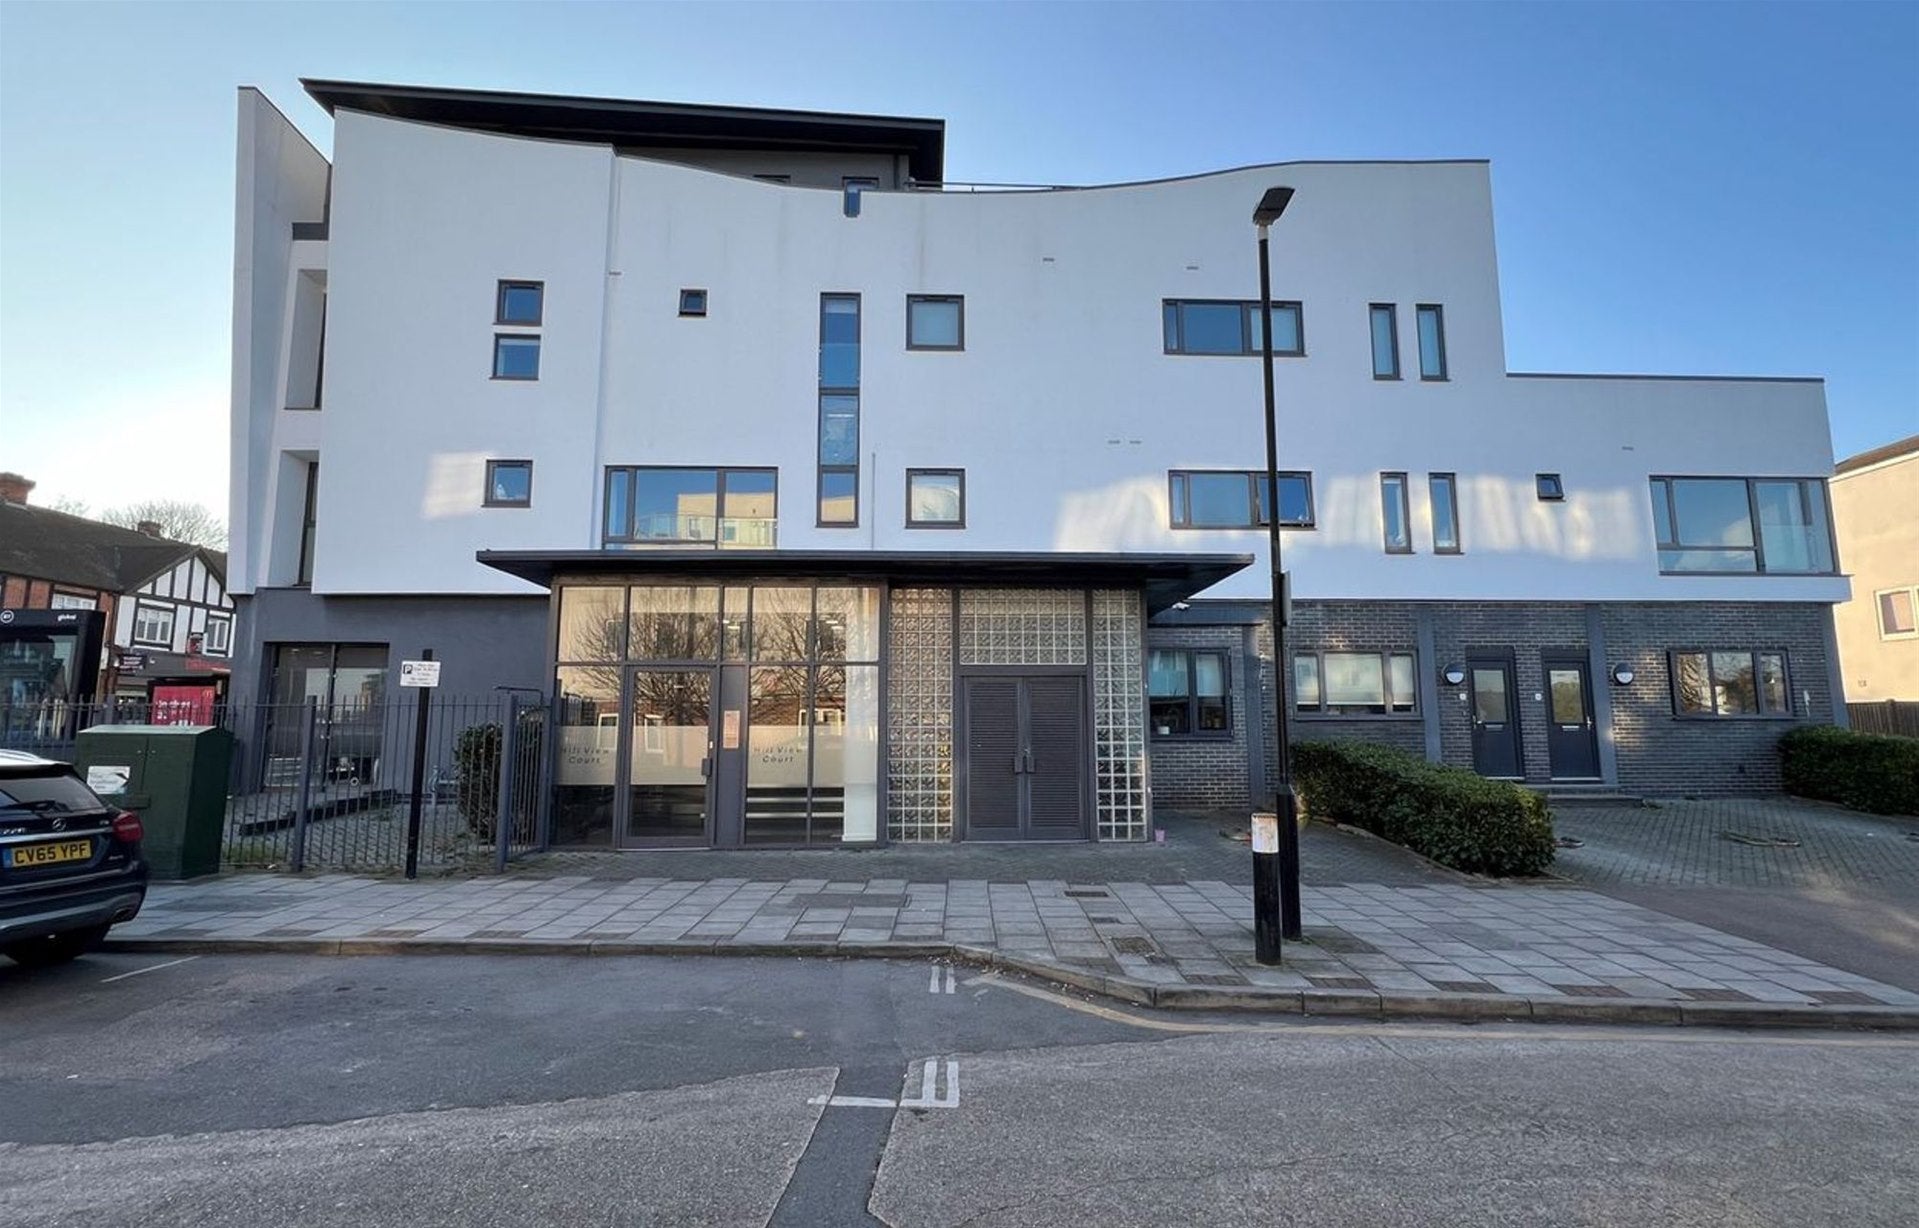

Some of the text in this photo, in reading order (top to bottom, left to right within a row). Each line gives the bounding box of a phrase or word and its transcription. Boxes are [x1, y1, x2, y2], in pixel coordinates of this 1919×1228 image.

[568, 755, 600, 765] Court
[762, 754, 794, 763] Court
[14, 842, 88, 865] CV65 YPF
